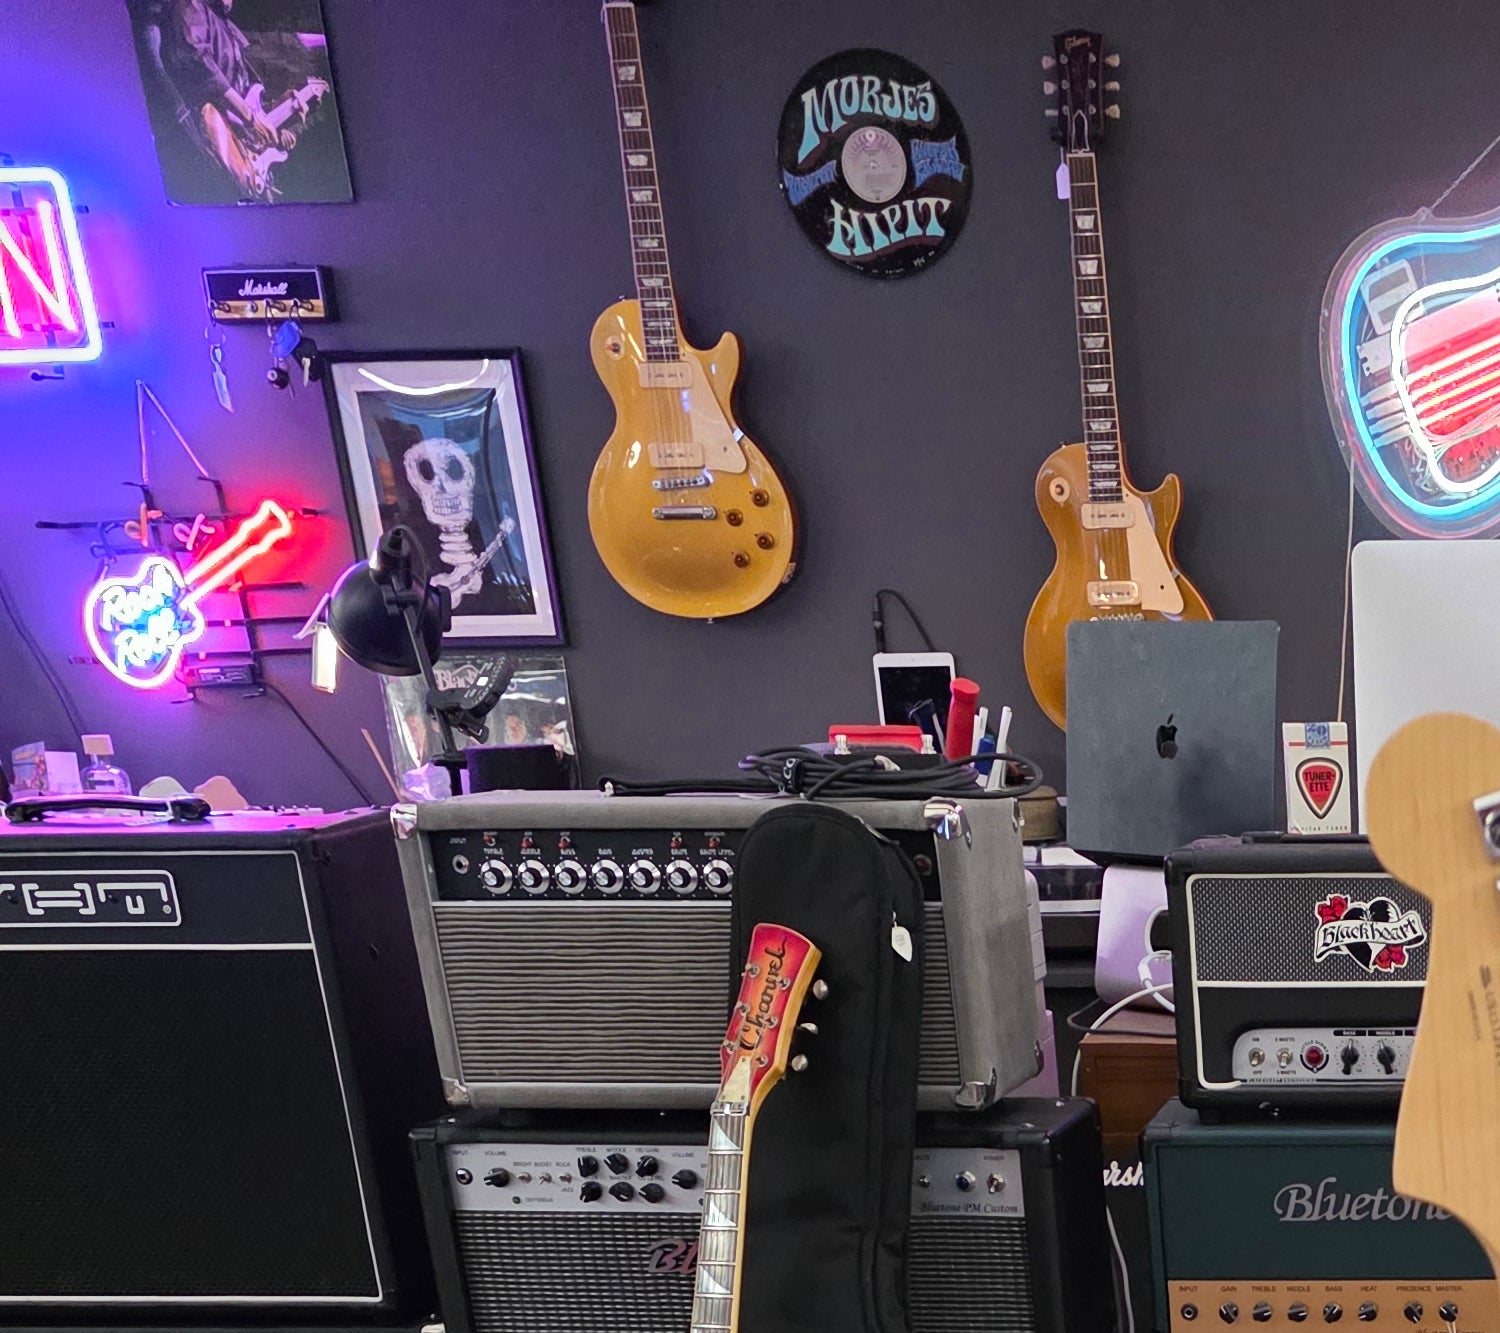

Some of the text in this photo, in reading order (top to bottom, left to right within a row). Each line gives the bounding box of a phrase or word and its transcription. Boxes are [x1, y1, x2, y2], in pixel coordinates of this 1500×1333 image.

[798, 75, 937, 164] MORJES
[825, 197, 952, 257] HIPIT
[239, 279, 288, 296] Marshall
[1309, 781, 1330, 793] ETTE
[1321, 917, 1418, 947] Blackheart
[984, 1203, 1019, 1214] Custom
